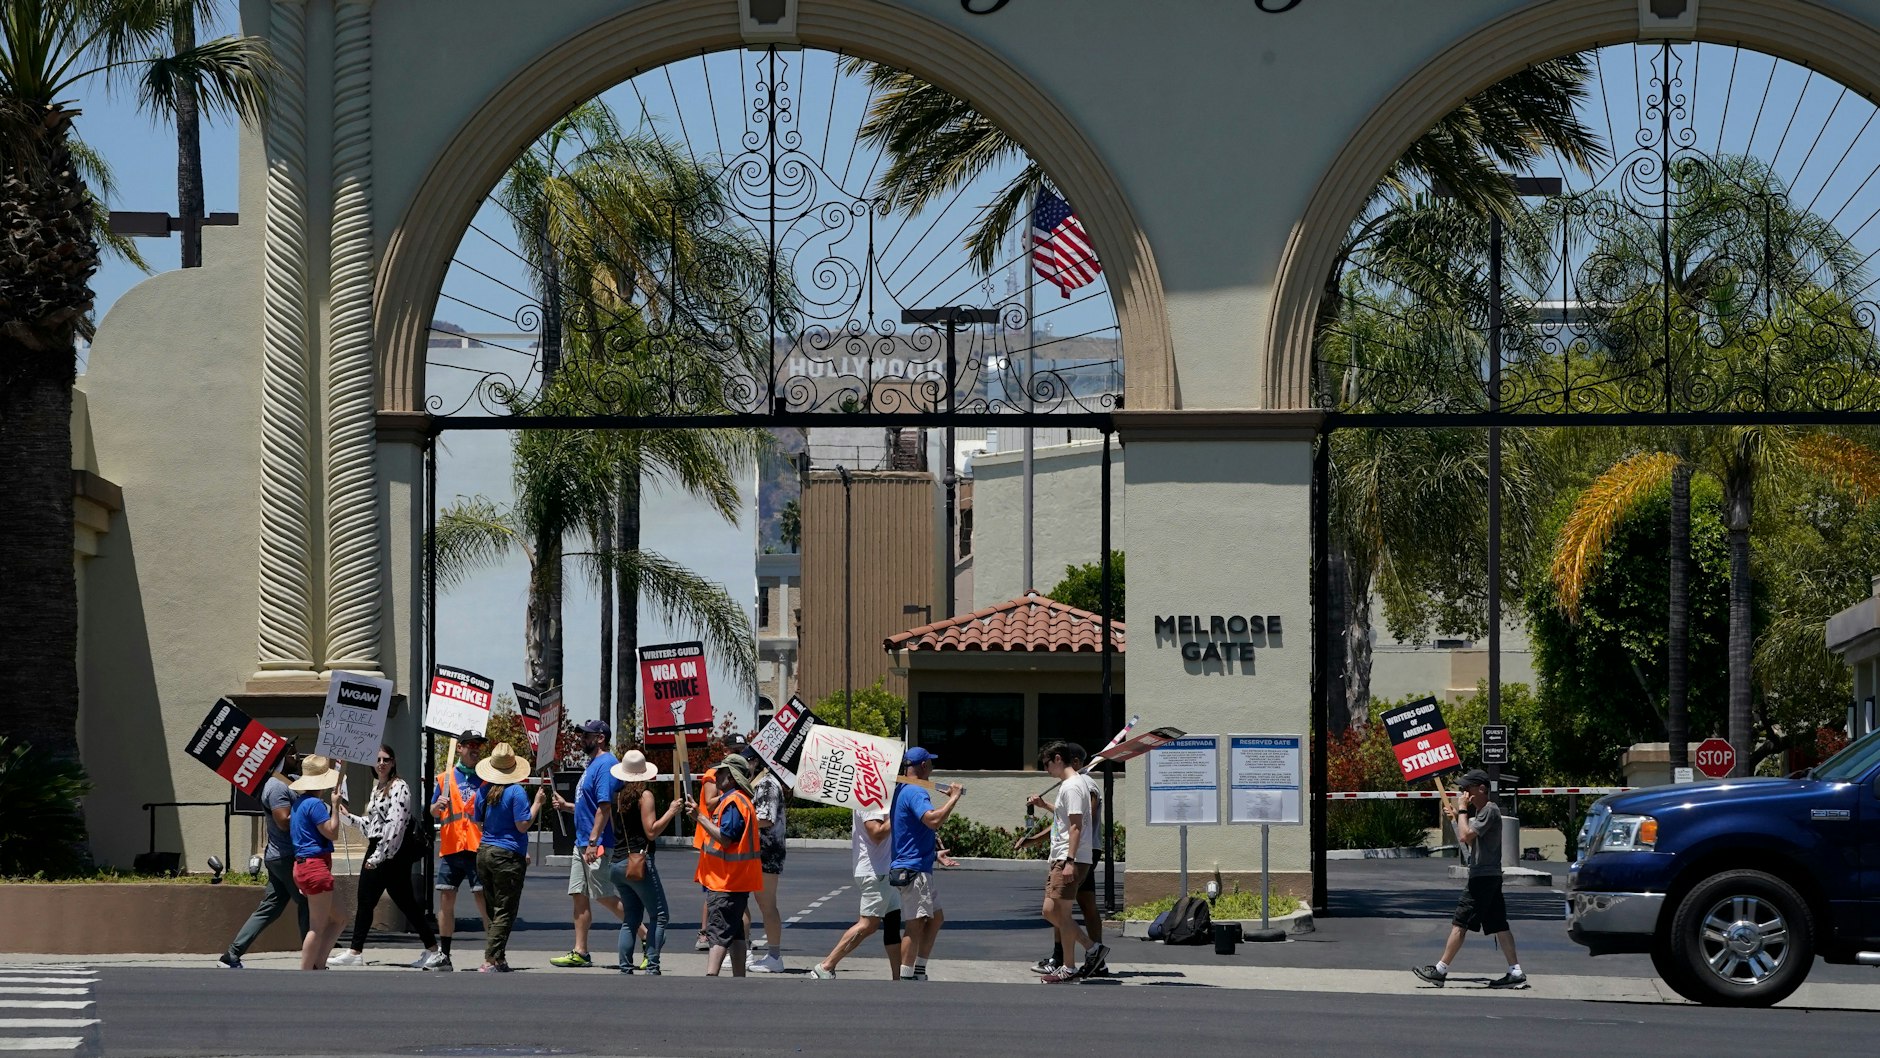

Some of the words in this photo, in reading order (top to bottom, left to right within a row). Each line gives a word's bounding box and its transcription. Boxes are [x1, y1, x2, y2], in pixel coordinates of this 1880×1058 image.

[789, 357, 943, 380] HOLLYWOOD
[1154, 615, 1282, 634] MELROSE
[643, 648, 677, 660] WRITERS
[677, 646, 700, 656] GUILD
[1181, 641, 1255, 661] GATE
[438, 668, 470, 683] WRITERS
[470, 676, 490, 690] GUILD
[650, 663, 678, 682] WGA
[680, 661, 698, 678] ON
[340, 687, 379, 703] WGAW
[435, 680, 488, 708] STRIKE!
[653, 677, 700, 700] STRIKE
[340, 709, 373, 724] CRUEL
[1386, 711, 1416, 726] WRITERS
[1415, 703, 1435, 716] GUILD
[193, 724, 218, 755] WRITERS
[213, 705, 231, 727] GUILD
[215, 730, 225, 741] OF
[324, 720, 344, 731] BUT
[1403, 722, 1433, 739] AMERICA
[215, 725, 241, 758] AMERICA
[323, 732, 347, 747] EVIL
[780, 734, 803, 764] WRITERS
[798, 716, 815, 737] GUILD
[1417, 739, 1431, 751] ON
[233, 731, 278, 788] STRIKE!
[235, 743, 250, 758] ON
[1401, 743, 1455, 773] STRIKE!
[1698, 750, 1733, 766] STOP
[820, 755, 829, 770] THE
[820, 748, 845, 799] WRITERS
[835, 764, 855, 803] GUILD
